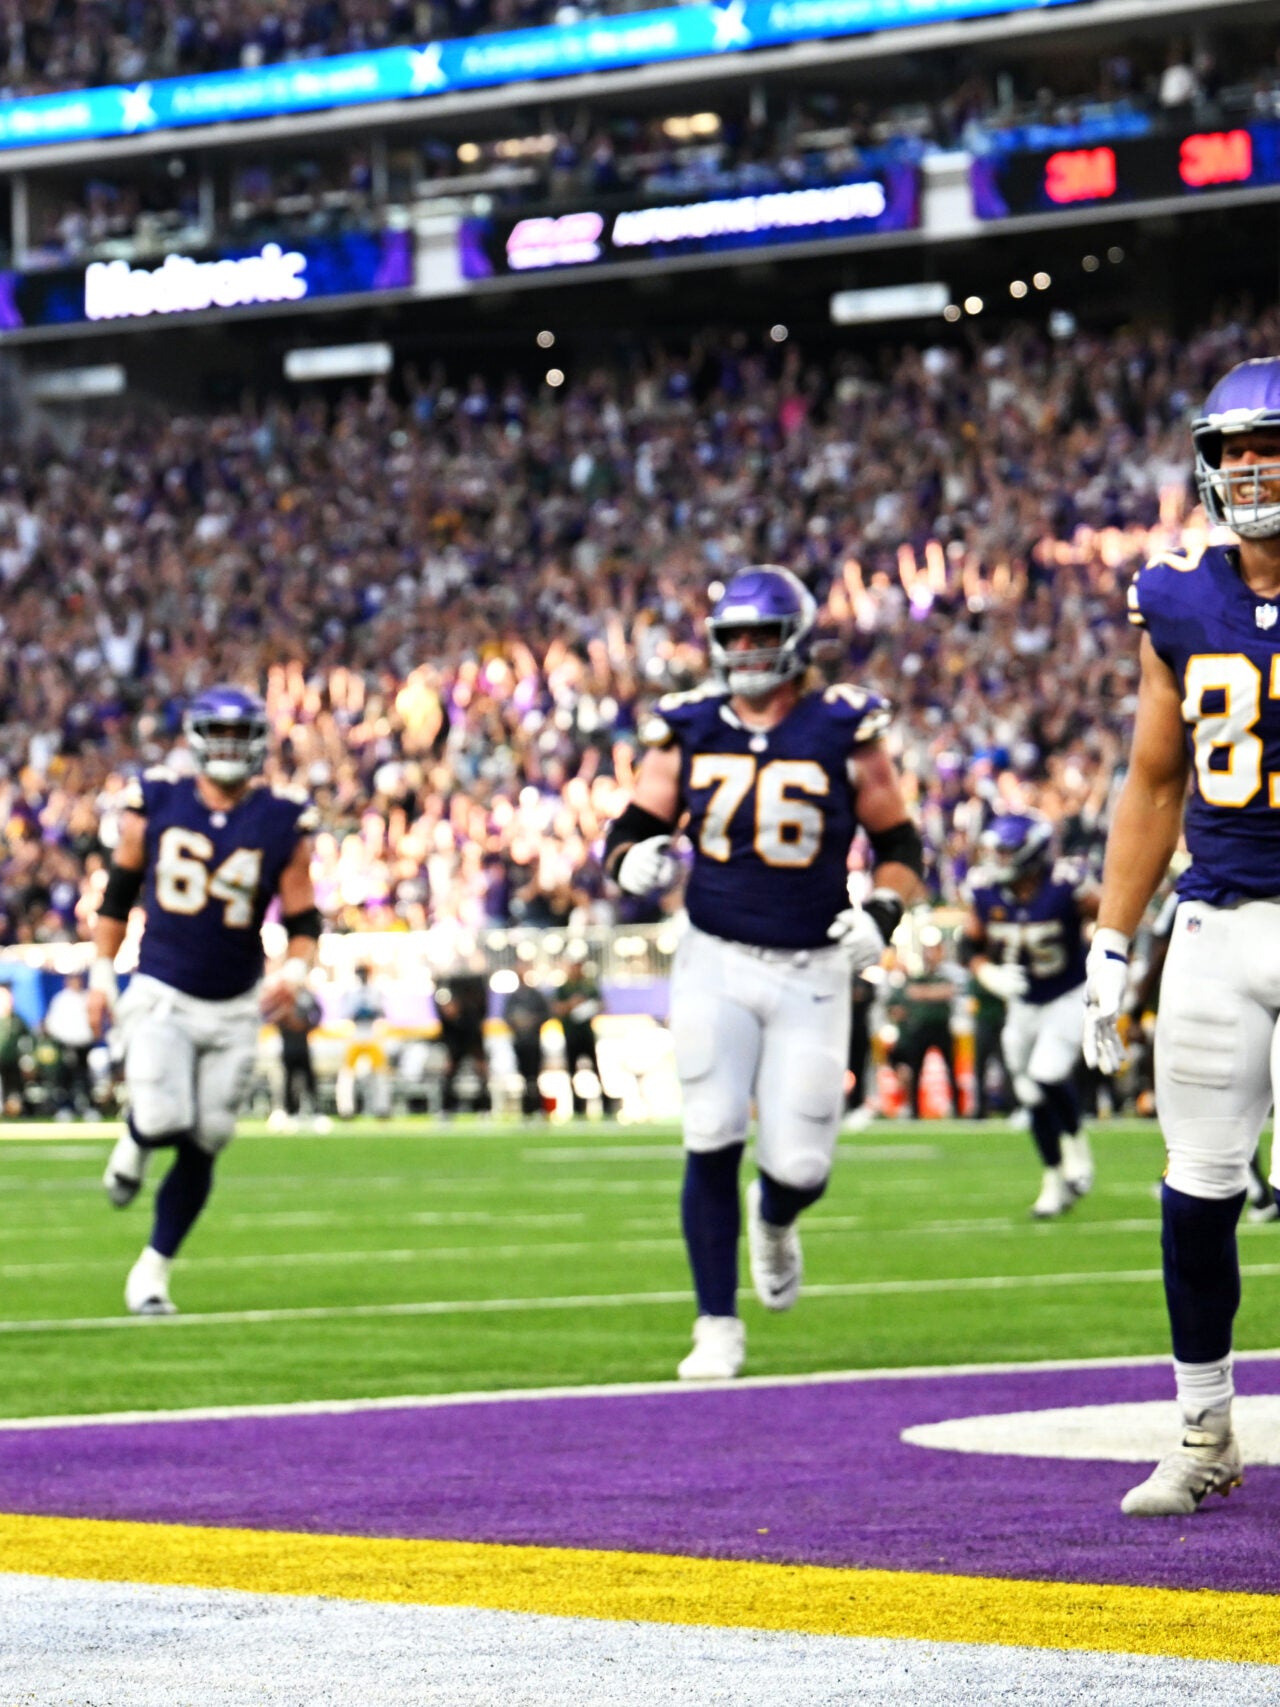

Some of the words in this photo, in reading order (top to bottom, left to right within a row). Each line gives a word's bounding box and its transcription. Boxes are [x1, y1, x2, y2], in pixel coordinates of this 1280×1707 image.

[689, 752, 830, 868] 76
[155, 826, 264, 929] 64
[986, 920, 1069, 979] 75
